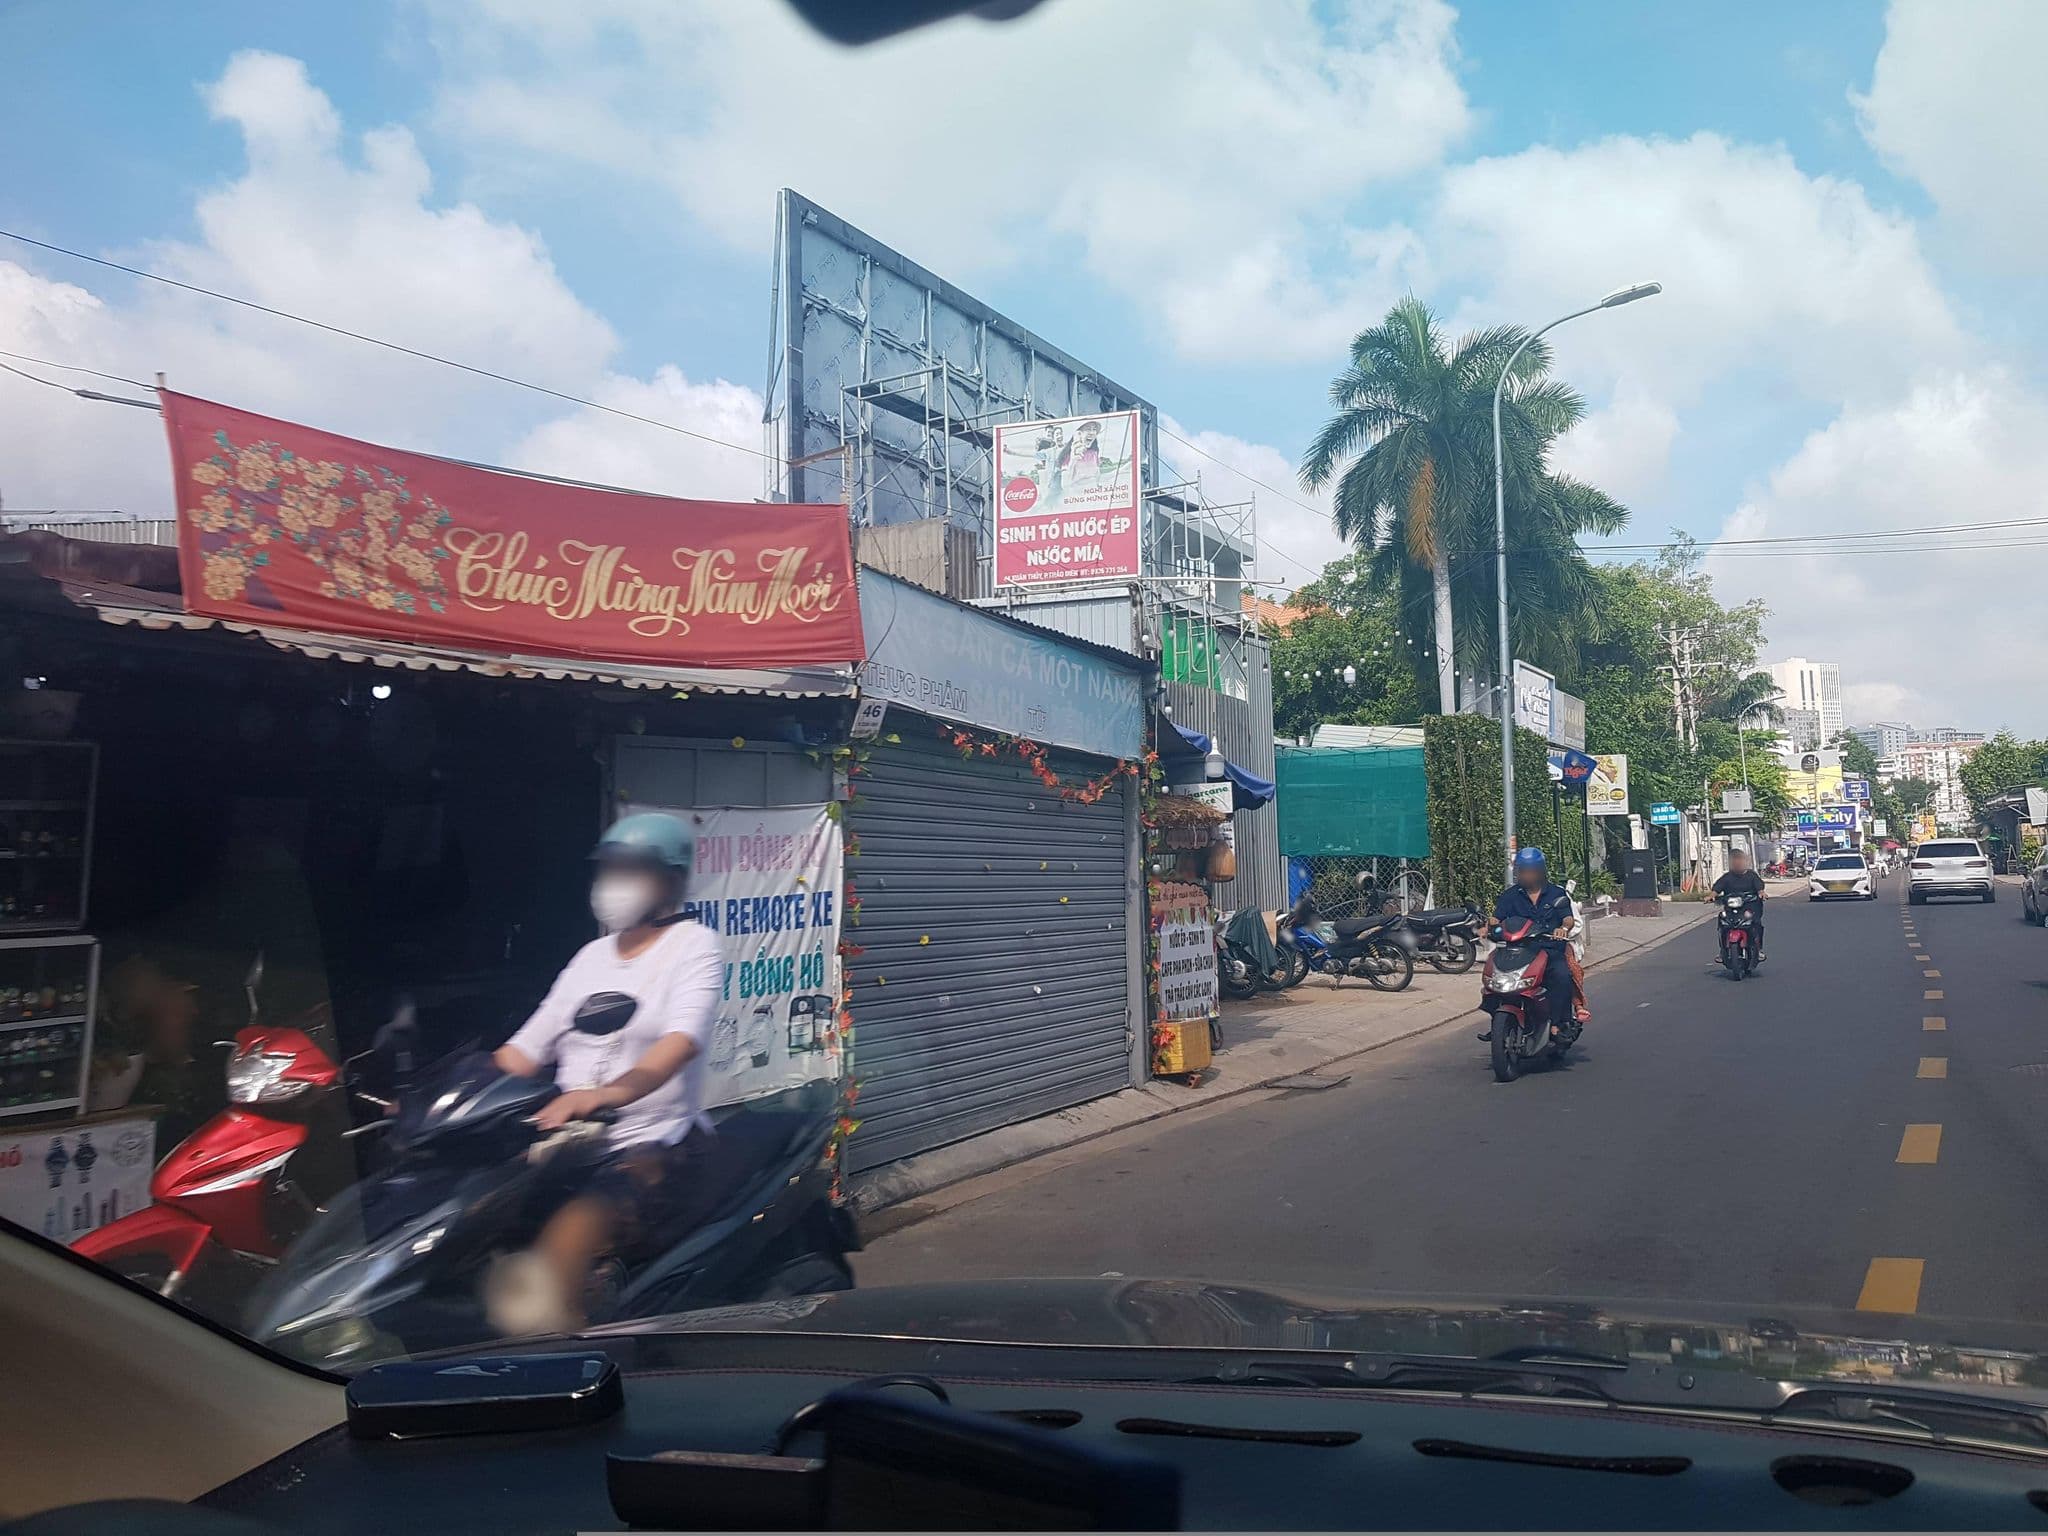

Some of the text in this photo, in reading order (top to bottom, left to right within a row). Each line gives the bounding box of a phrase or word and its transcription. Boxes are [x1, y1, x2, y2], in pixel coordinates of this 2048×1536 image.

[1000, 515, 1131, 544] SINH TỐ NƯỚC ÉP
[1027, 543, 1104, 566] NƯỚC MÍA
[444, 527, 841, 638] Chúc Mừng Năm Mới
[864, 660, 916, 699] THỰC
[863, 705, 882, 718] 46
[695, 836, 732, 873] PIN
[725, 892, 805, 936] REMOTE
[812, 891, 833, 927] XE
